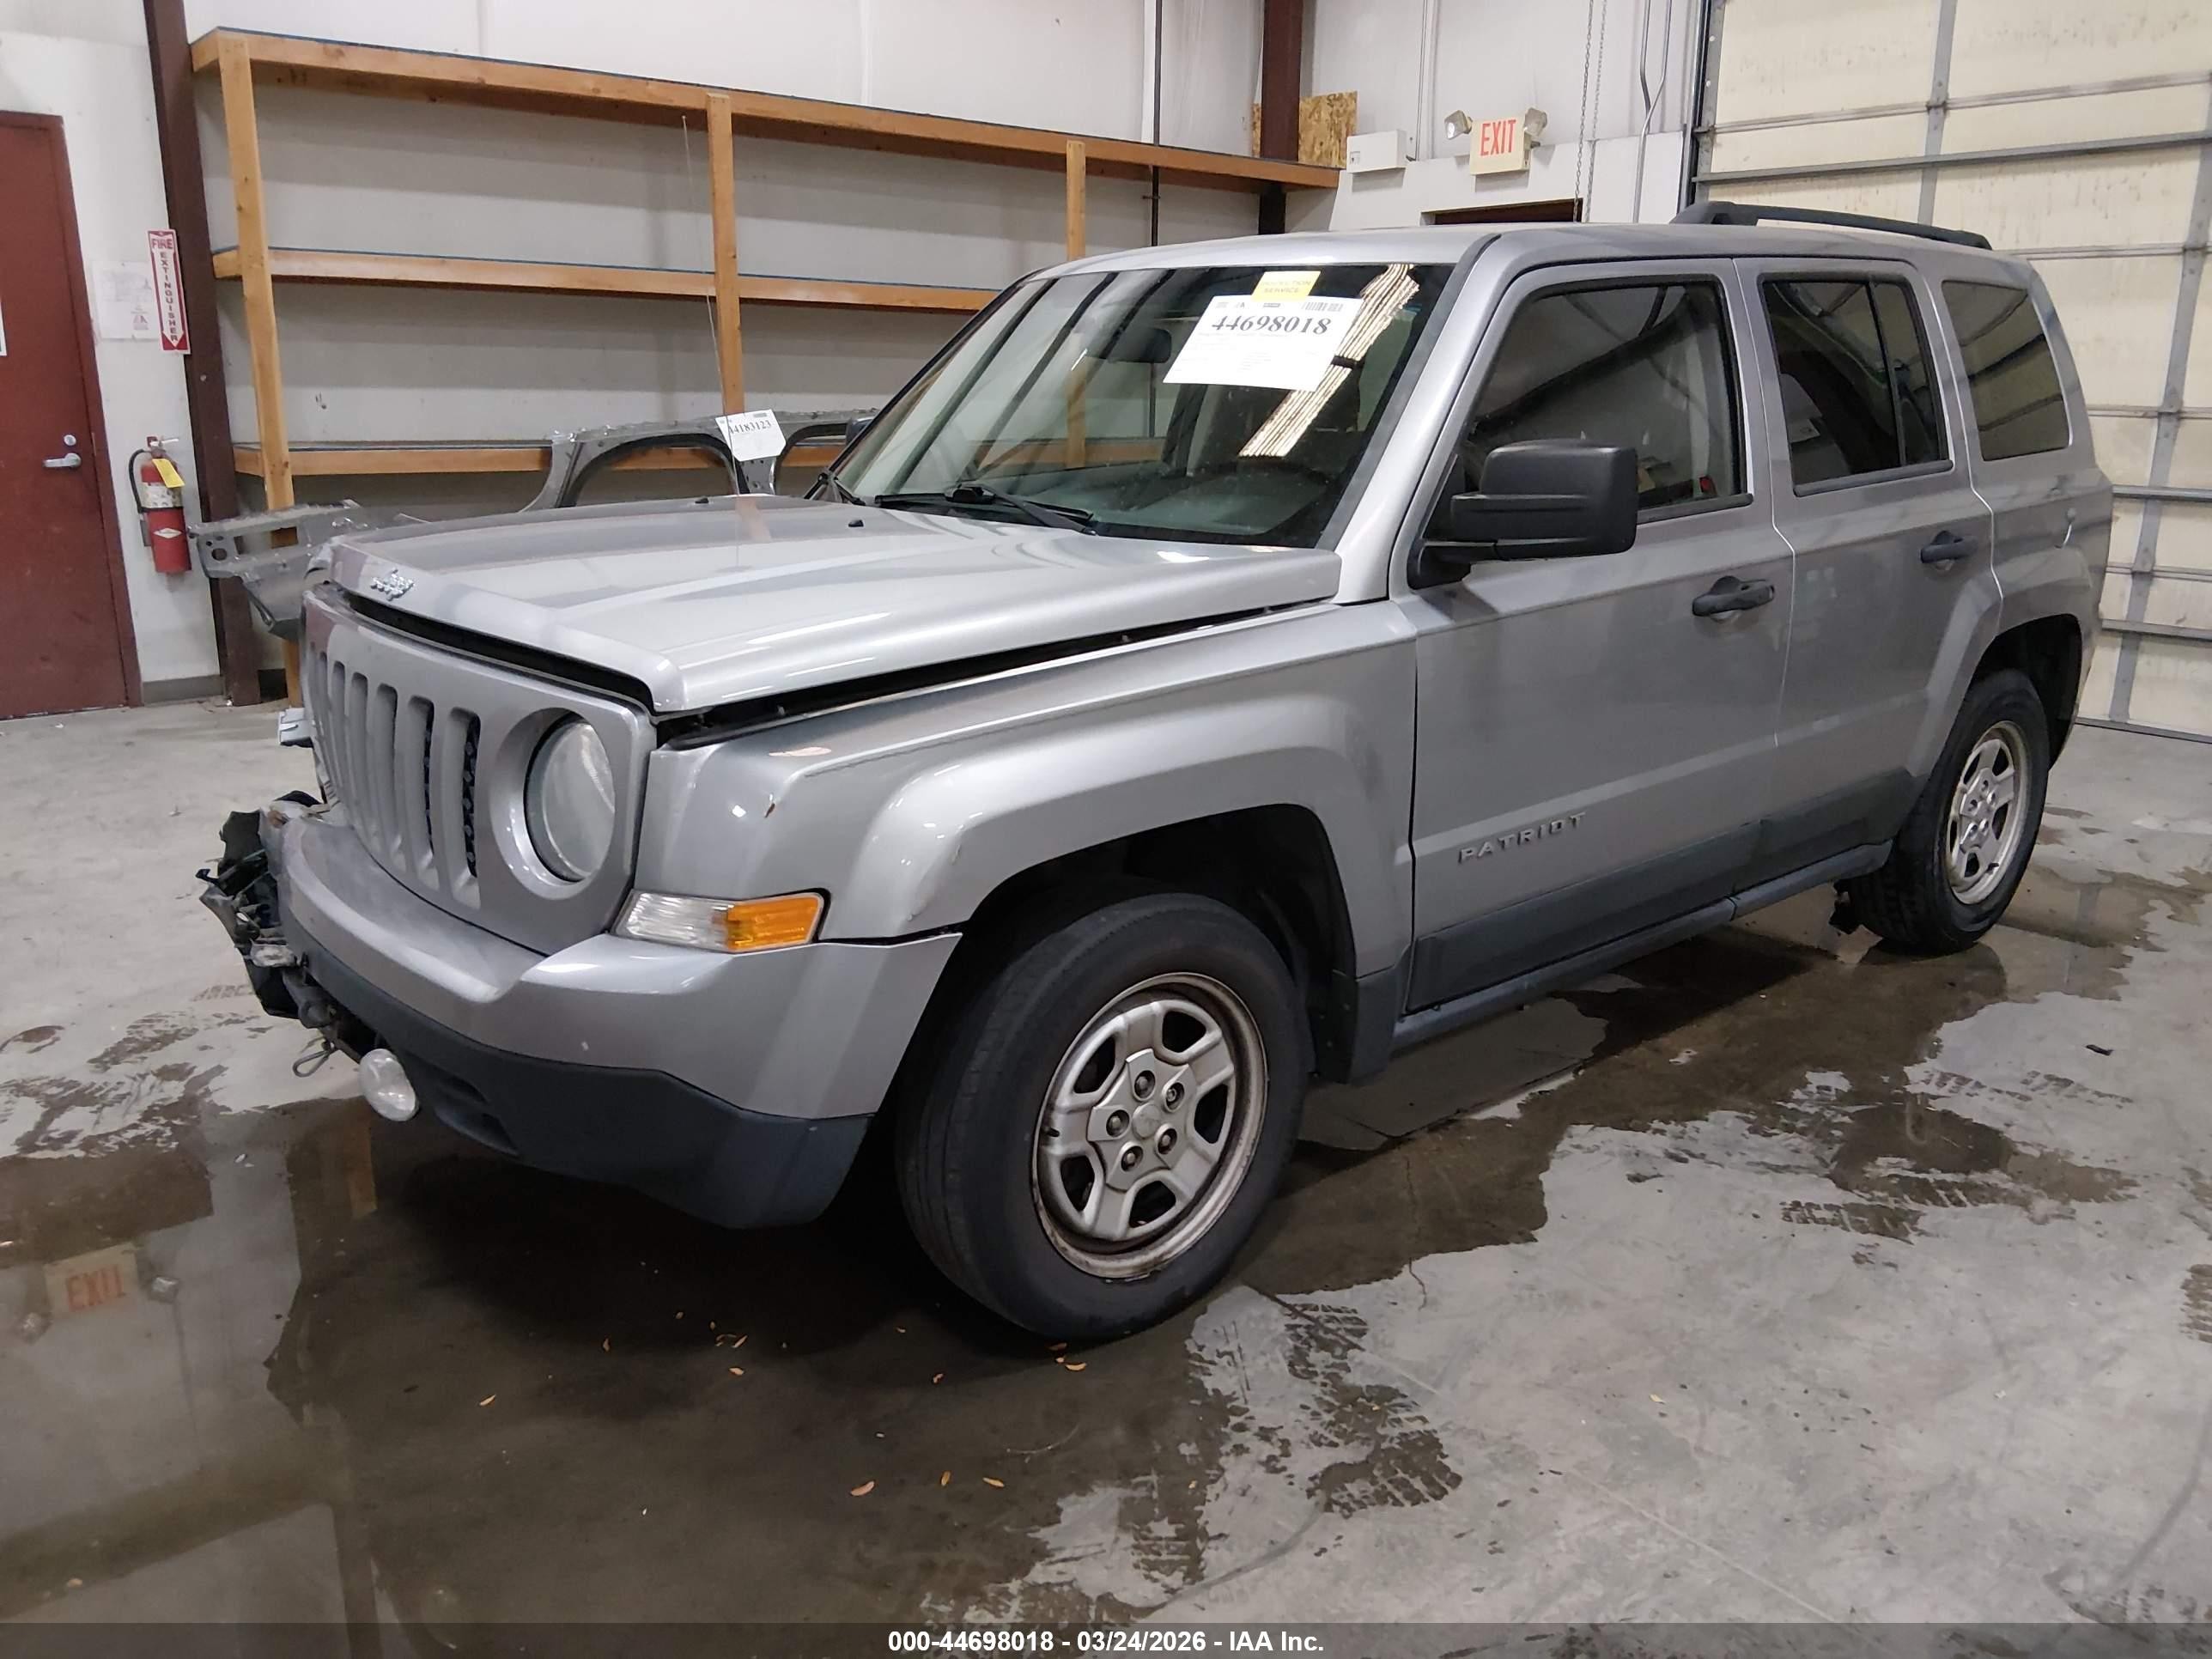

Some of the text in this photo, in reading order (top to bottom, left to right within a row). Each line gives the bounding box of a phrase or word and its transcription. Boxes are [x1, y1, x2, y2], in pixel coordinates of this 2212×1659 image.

[1480, 118, 1516, 156] EXIT
[151, 239, 173, 249] FIRE
[160, 252, 178, 342] EXTINGUISHER
[1212, 315, 1332, 335] 44698018
[1458, 812, 1586, 864] PATRIOT
